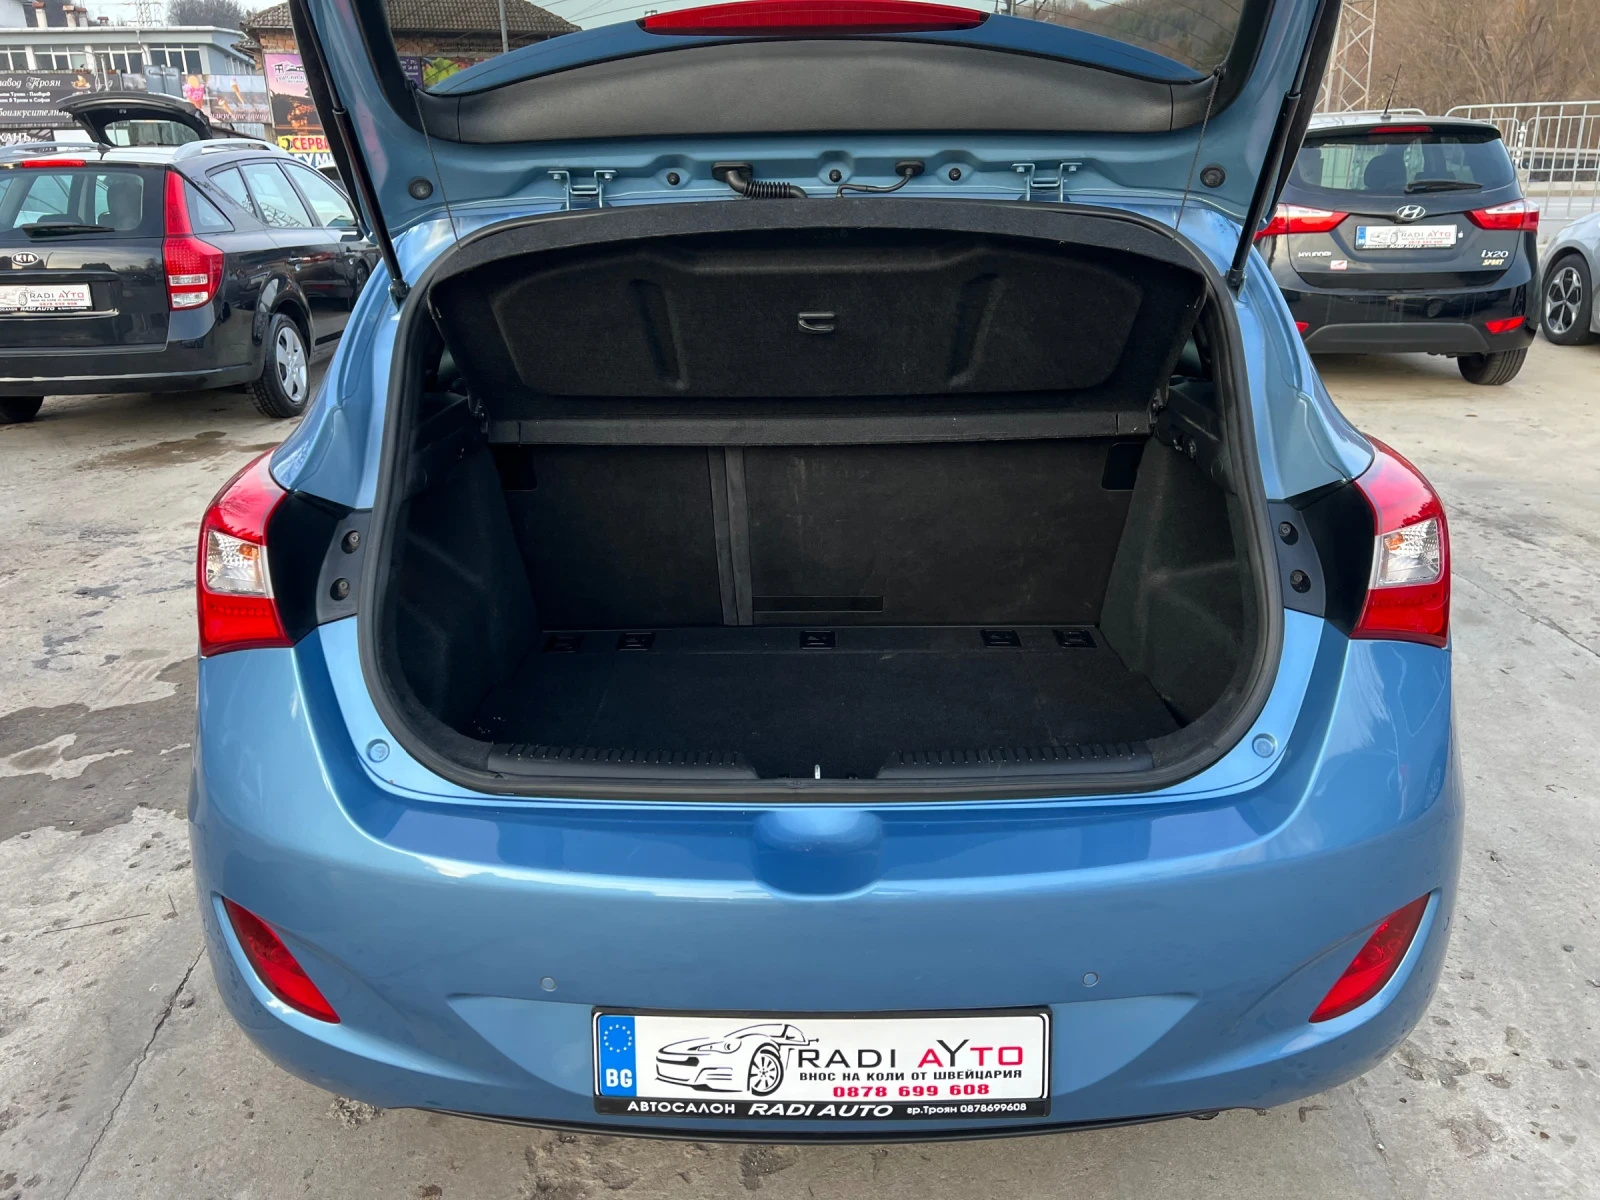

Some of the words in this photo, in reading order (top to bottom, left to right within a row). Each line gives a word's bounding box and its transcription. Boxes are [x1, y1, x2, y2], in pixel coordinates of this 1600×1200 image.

[15, 254, 35, 263] KIA
[798, 1048, 896, 1068] RADI
[605, 1068, 633, 1088] BG
[799, 1072, 836, 1081] ВНОС
[842, 1072, 860, 1081] НА
[866, 1072, 905, 1081] КОЛИ
[911, 1071, 927, 1081] ОТ
[933, 1068, 1022, 1080] ШВЕЙЦАРИЯ
[833, 1086, 888, 1098] 0878
[898, 1085, 939, 1097] 699
[949, 1083, 990, 1096] 608
[627, 1100, 736, 1114] АВТОСАЛОН
[747, 1103, 815, 1116] RADI
[816, 1104, 894, 1117] AUTO
[906, 1105, 958, 1115] гр.Троян
[960, 1102, 1027, 1113] 0878699608
